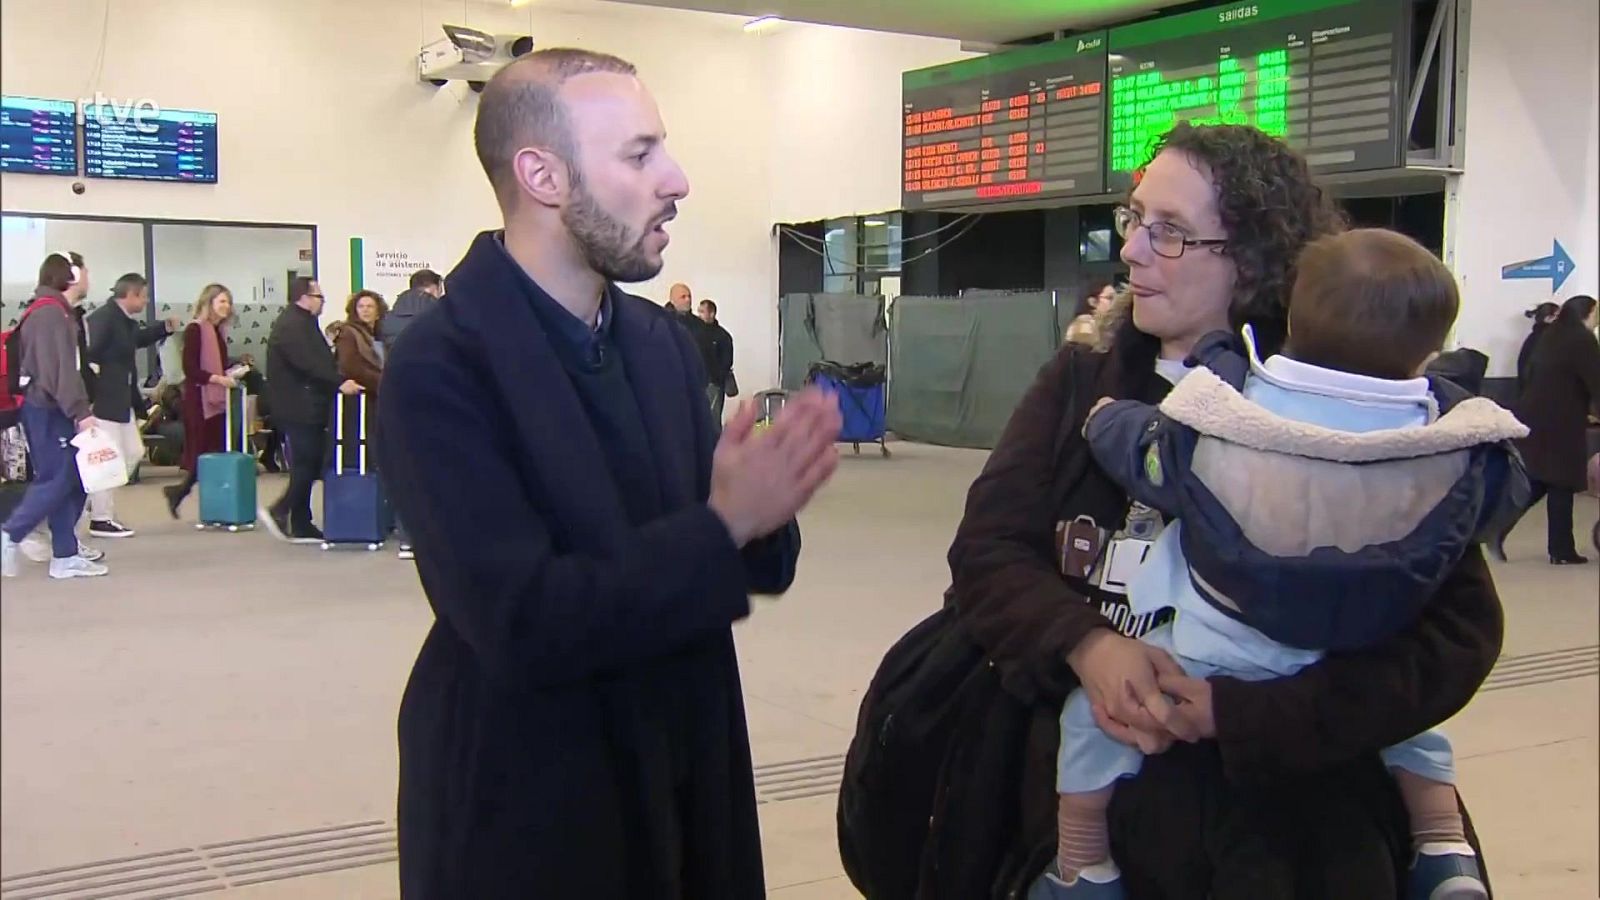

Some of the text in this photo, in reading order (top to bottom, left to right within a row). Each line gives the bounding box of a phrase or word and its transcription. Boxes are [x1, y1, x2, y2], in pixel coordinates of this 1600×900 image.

[1218, 5, 1258, 23] salidas
[375, 251, 408, 260] Servicio
[389, 261, 430, 269] asistencia
